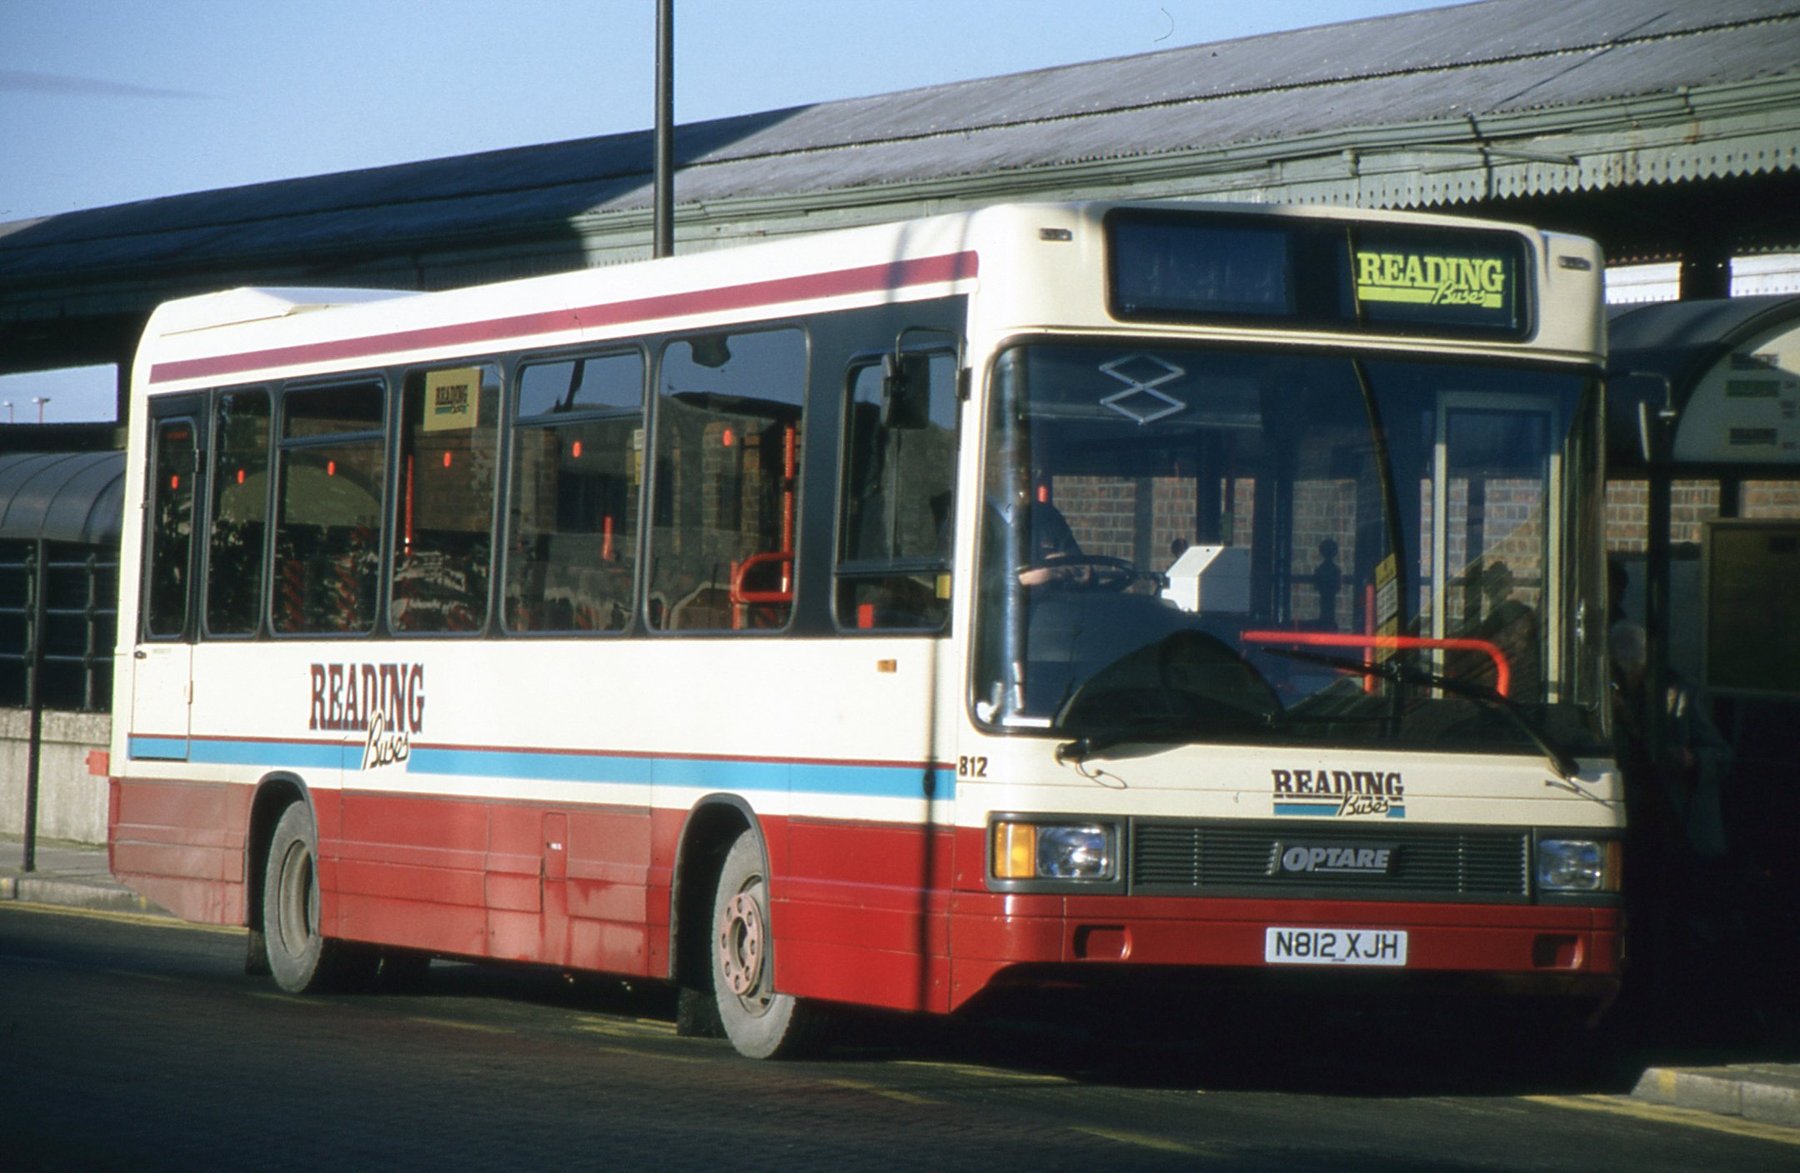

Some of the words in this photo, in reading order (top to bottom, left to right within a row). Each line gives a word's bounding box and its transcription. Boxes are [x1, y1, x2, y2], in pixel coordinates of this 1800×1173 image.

[1357, 252, 1505, 291] READING
[1431, 280, 1488, 305] Buses
[309, 663, 425, 735] READING
[362, 711, 409, 771] Buses
[959, 755, 988, 777] 812
[1271, 769, 1404, 802] READING
[1336, 791, 1390, 816] Buses
[1283, 847, 1391, 872] OPTARE
[1276, 931, 1337, 957] N812
[1345, 932, 1398, 959] XJH
